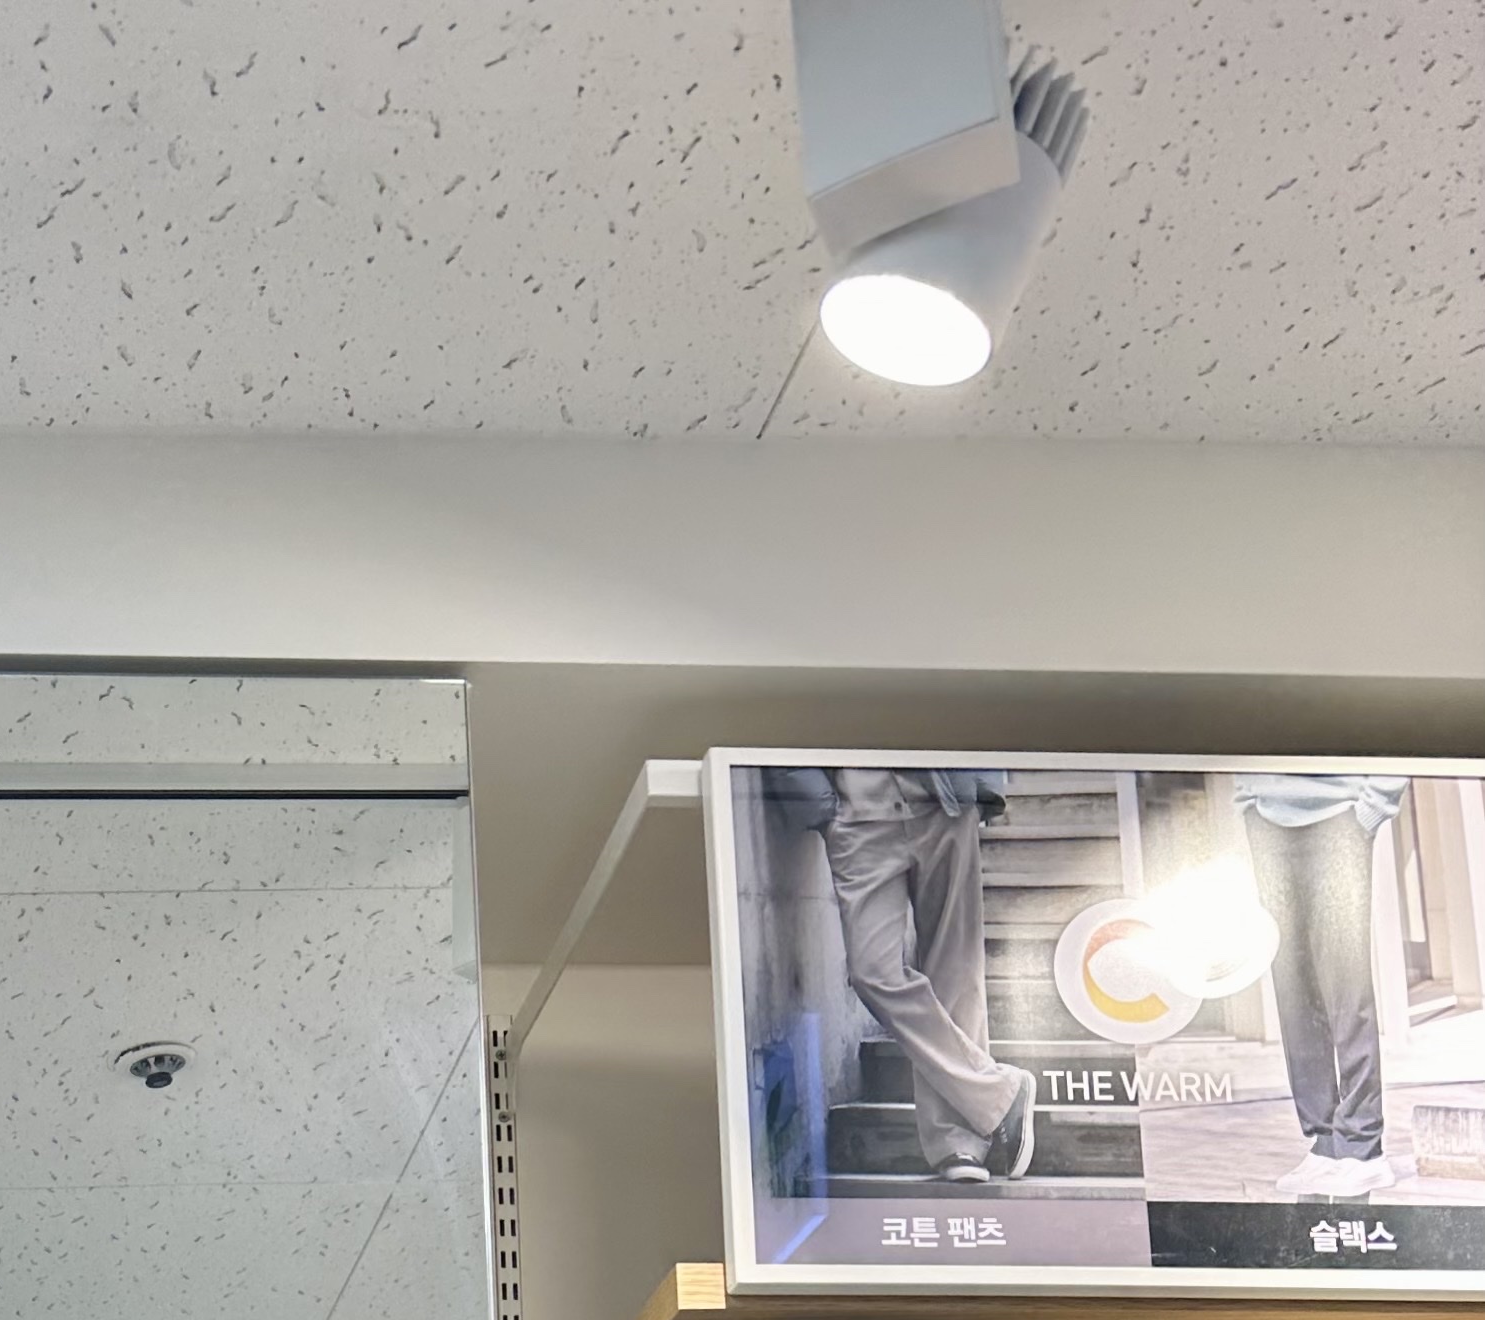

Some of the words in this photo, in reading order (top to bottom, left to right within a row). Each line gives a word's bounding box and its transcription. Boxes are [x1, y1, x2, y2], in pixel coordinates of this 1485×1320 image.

[1041, 1068, 1114, 1104] THE
[1120, 1070, 1234, 1104] WARM
[880, 1216, 942, 1250] 코튼
[946, 1216, 1008, 1250] 팬츠
[1308, 1218, 1398, 1255] 슬랙스
